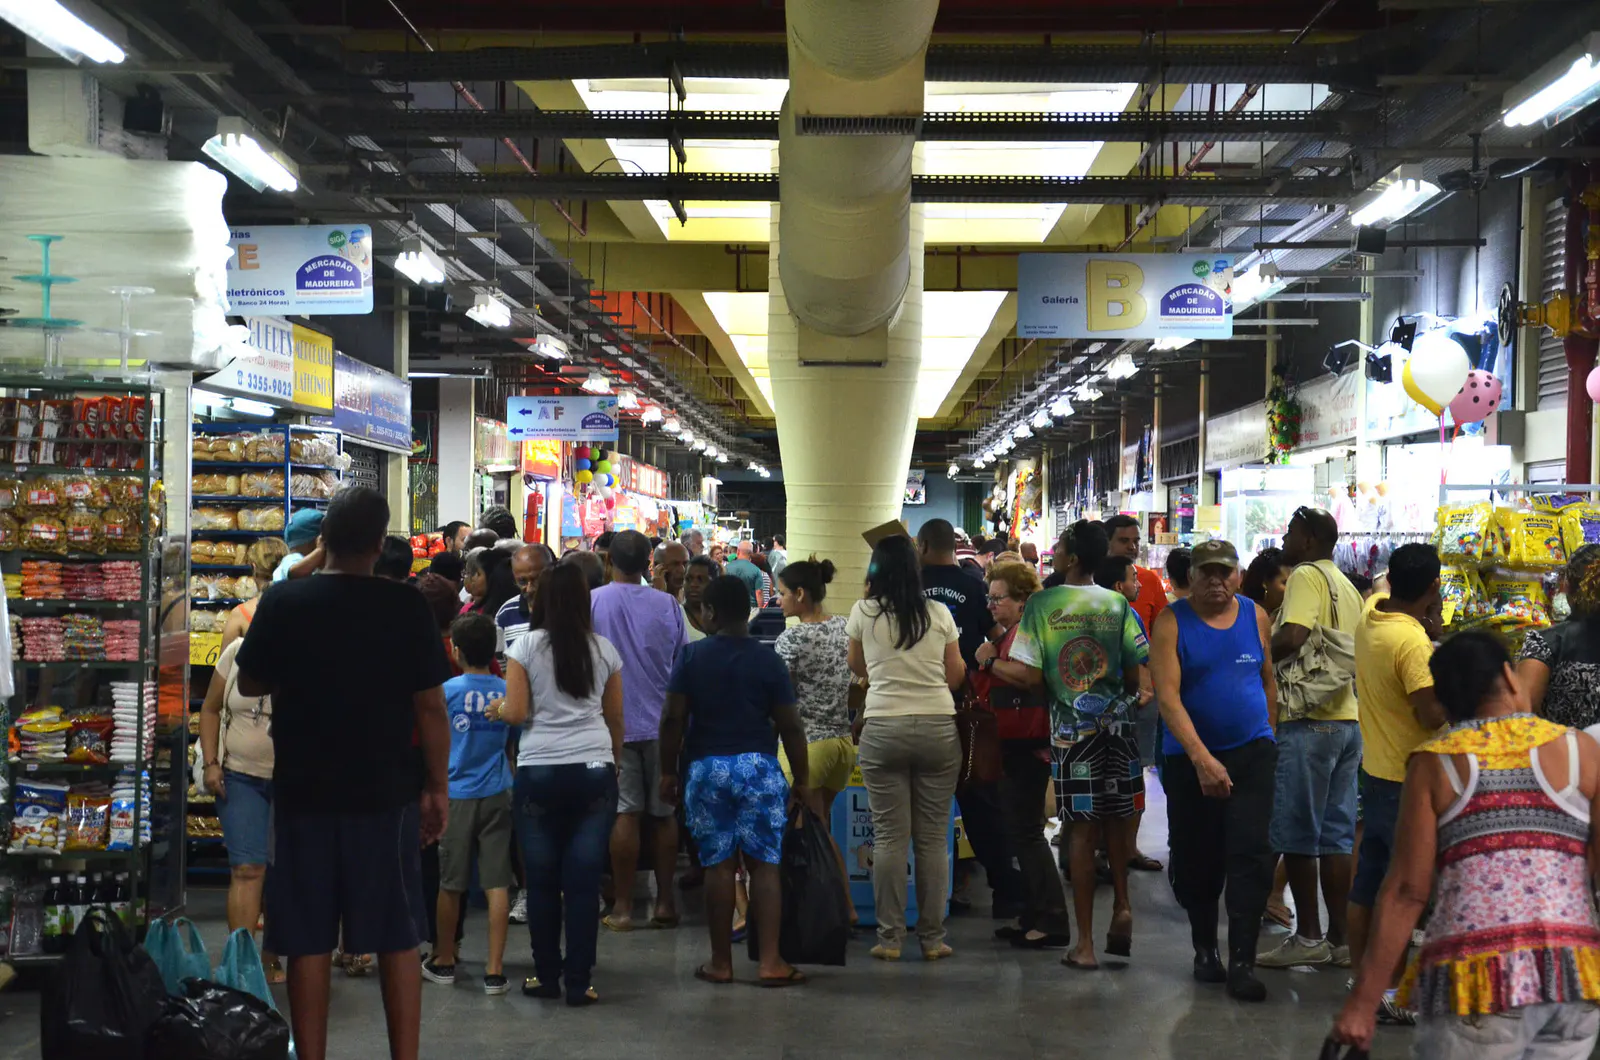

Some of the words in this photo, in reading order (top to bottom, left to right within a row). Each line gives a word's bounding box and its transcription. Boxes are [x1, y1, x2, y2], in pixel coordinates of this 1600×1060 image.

[330, 234, 346, 245] SIGA
[304, 260, 353, 274] MERCADÃO
[1194, 264, 1210, 274] SIGA
[305, 280, 355, 288] MADUREIRA
[1042, 296, 1078, 304] Galeria
[1086, 259, 1147, 332] B
[1170, 288, 1215, 300] MERCADÃO
[248, 373, 292, 396] 3355-9022
[554, 406, 564, 420] F
